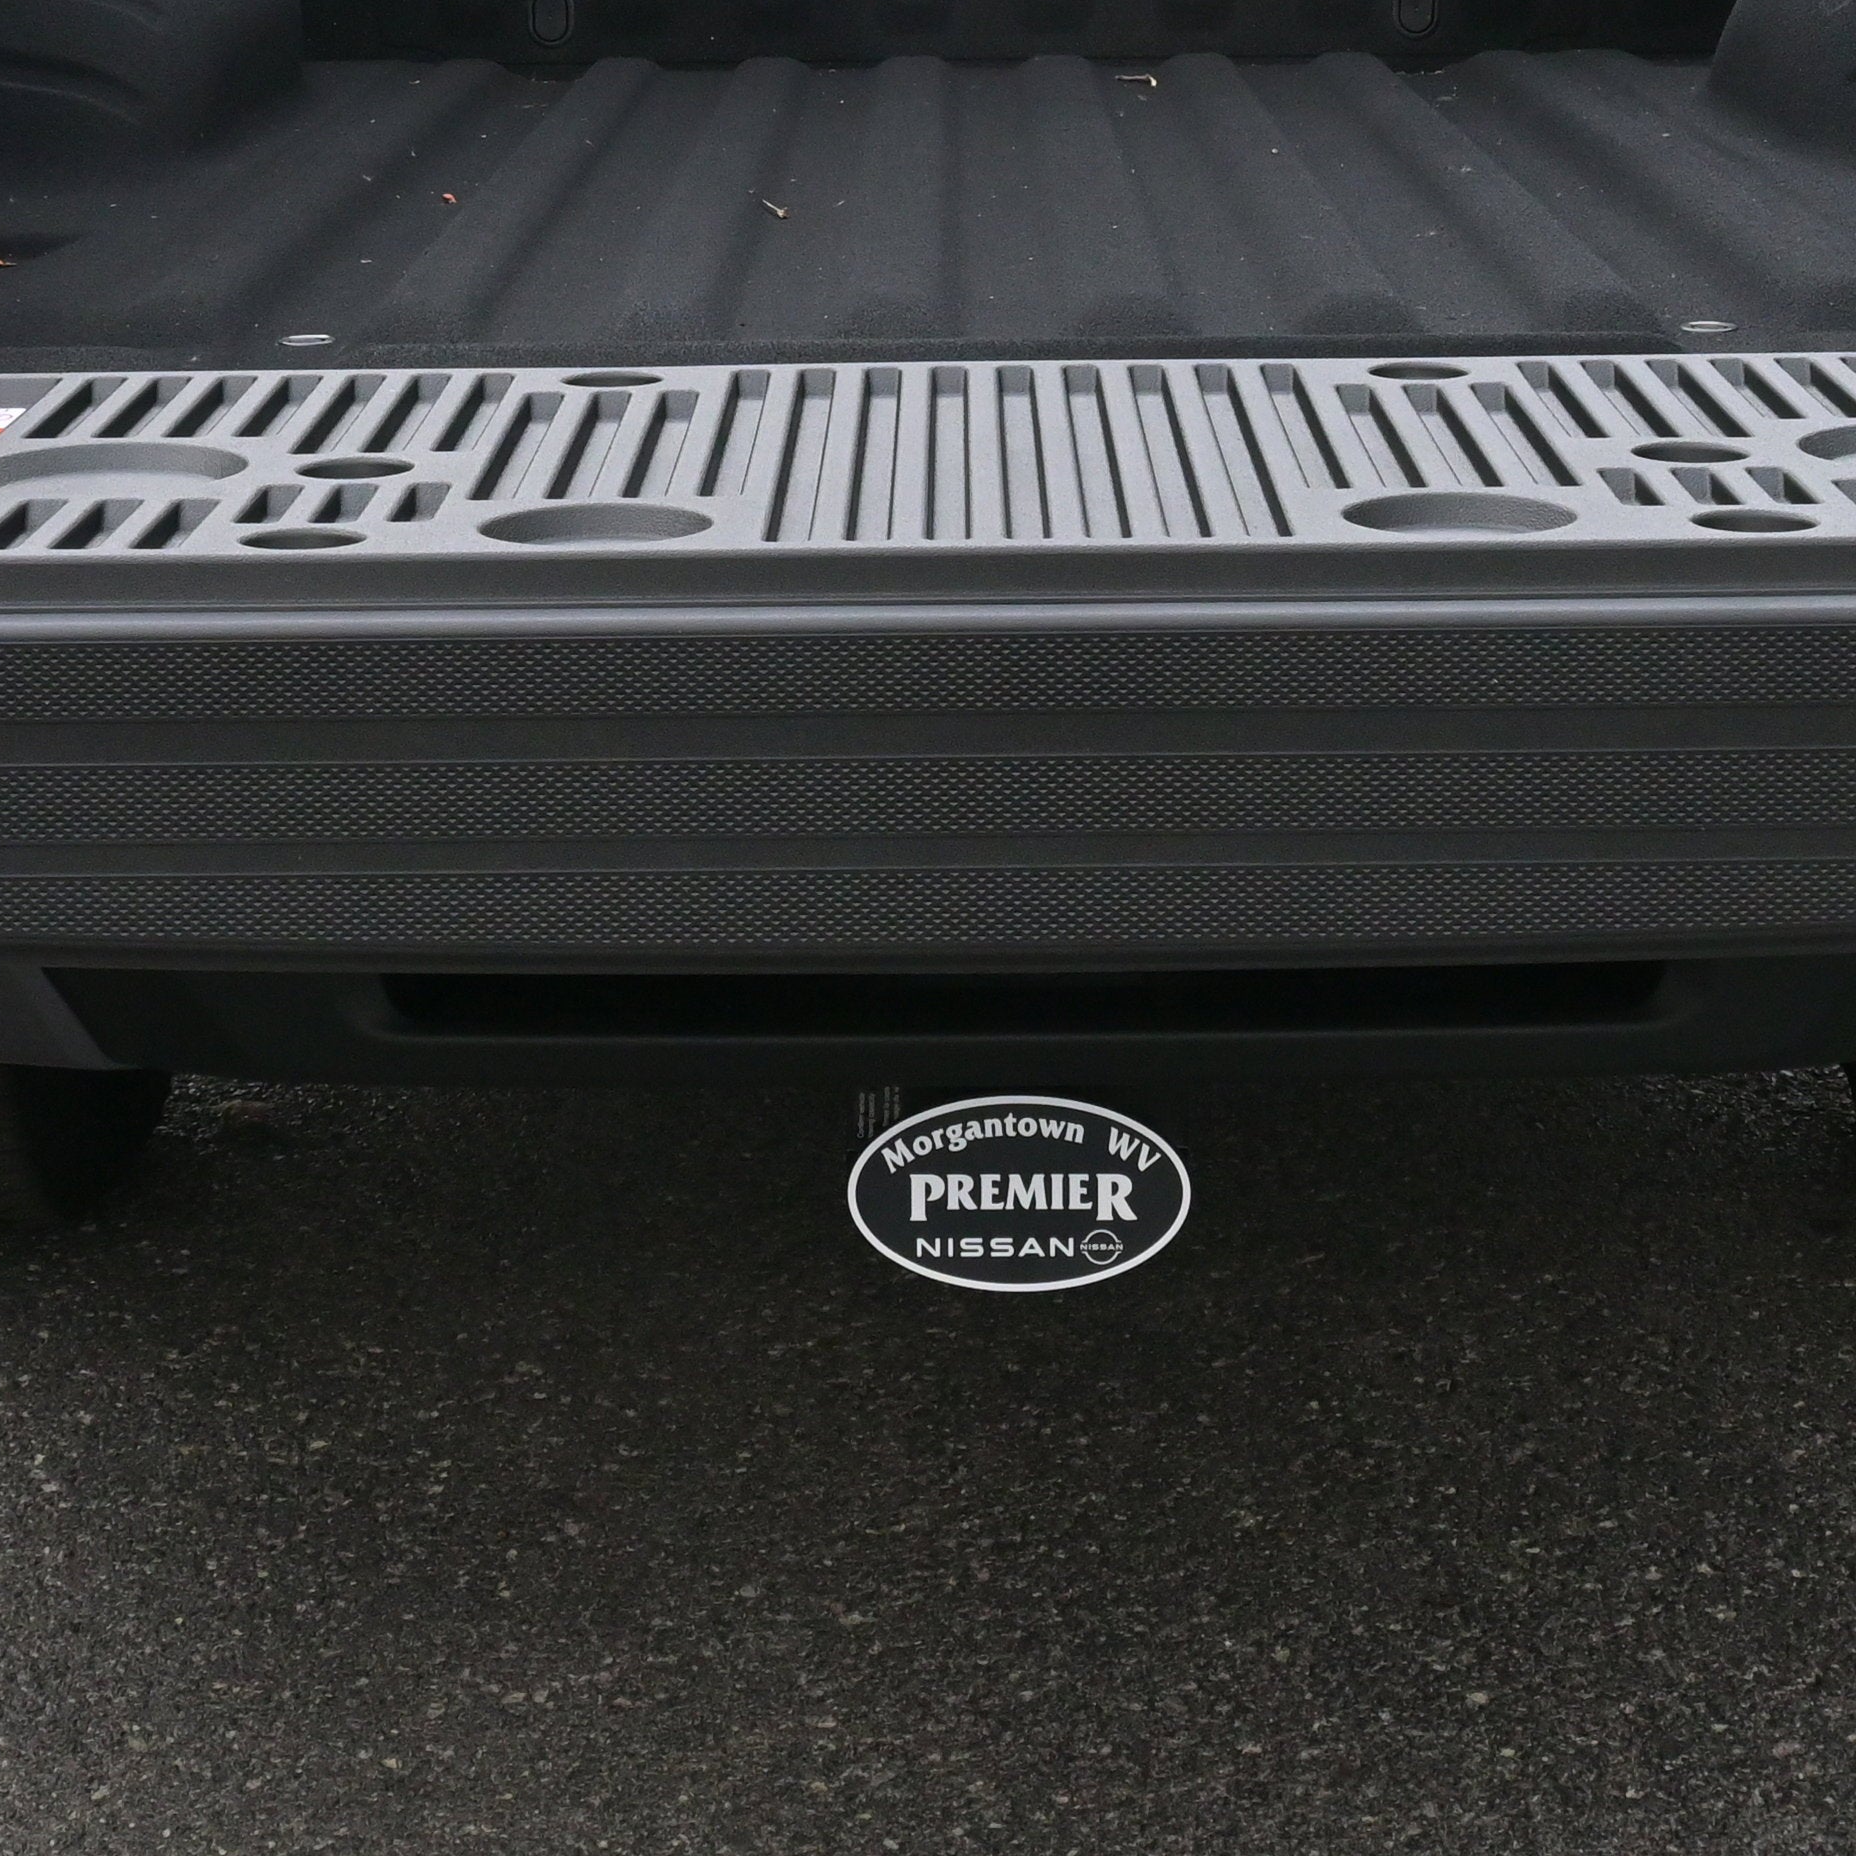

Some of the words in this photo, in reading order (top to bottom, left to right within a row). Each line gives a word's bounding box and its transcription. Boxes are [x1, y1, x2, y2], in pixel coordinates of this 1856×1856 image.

[881, 1113, 1085, 1174] Morgantown
[1107, 1126, 1162, 1172] WV
[909, 1174, 1138, 1221] PREMIER
[916, 1237, 1075, 1257] NISSAN
[1080, 1243, 1124, 1251] NISSAN
